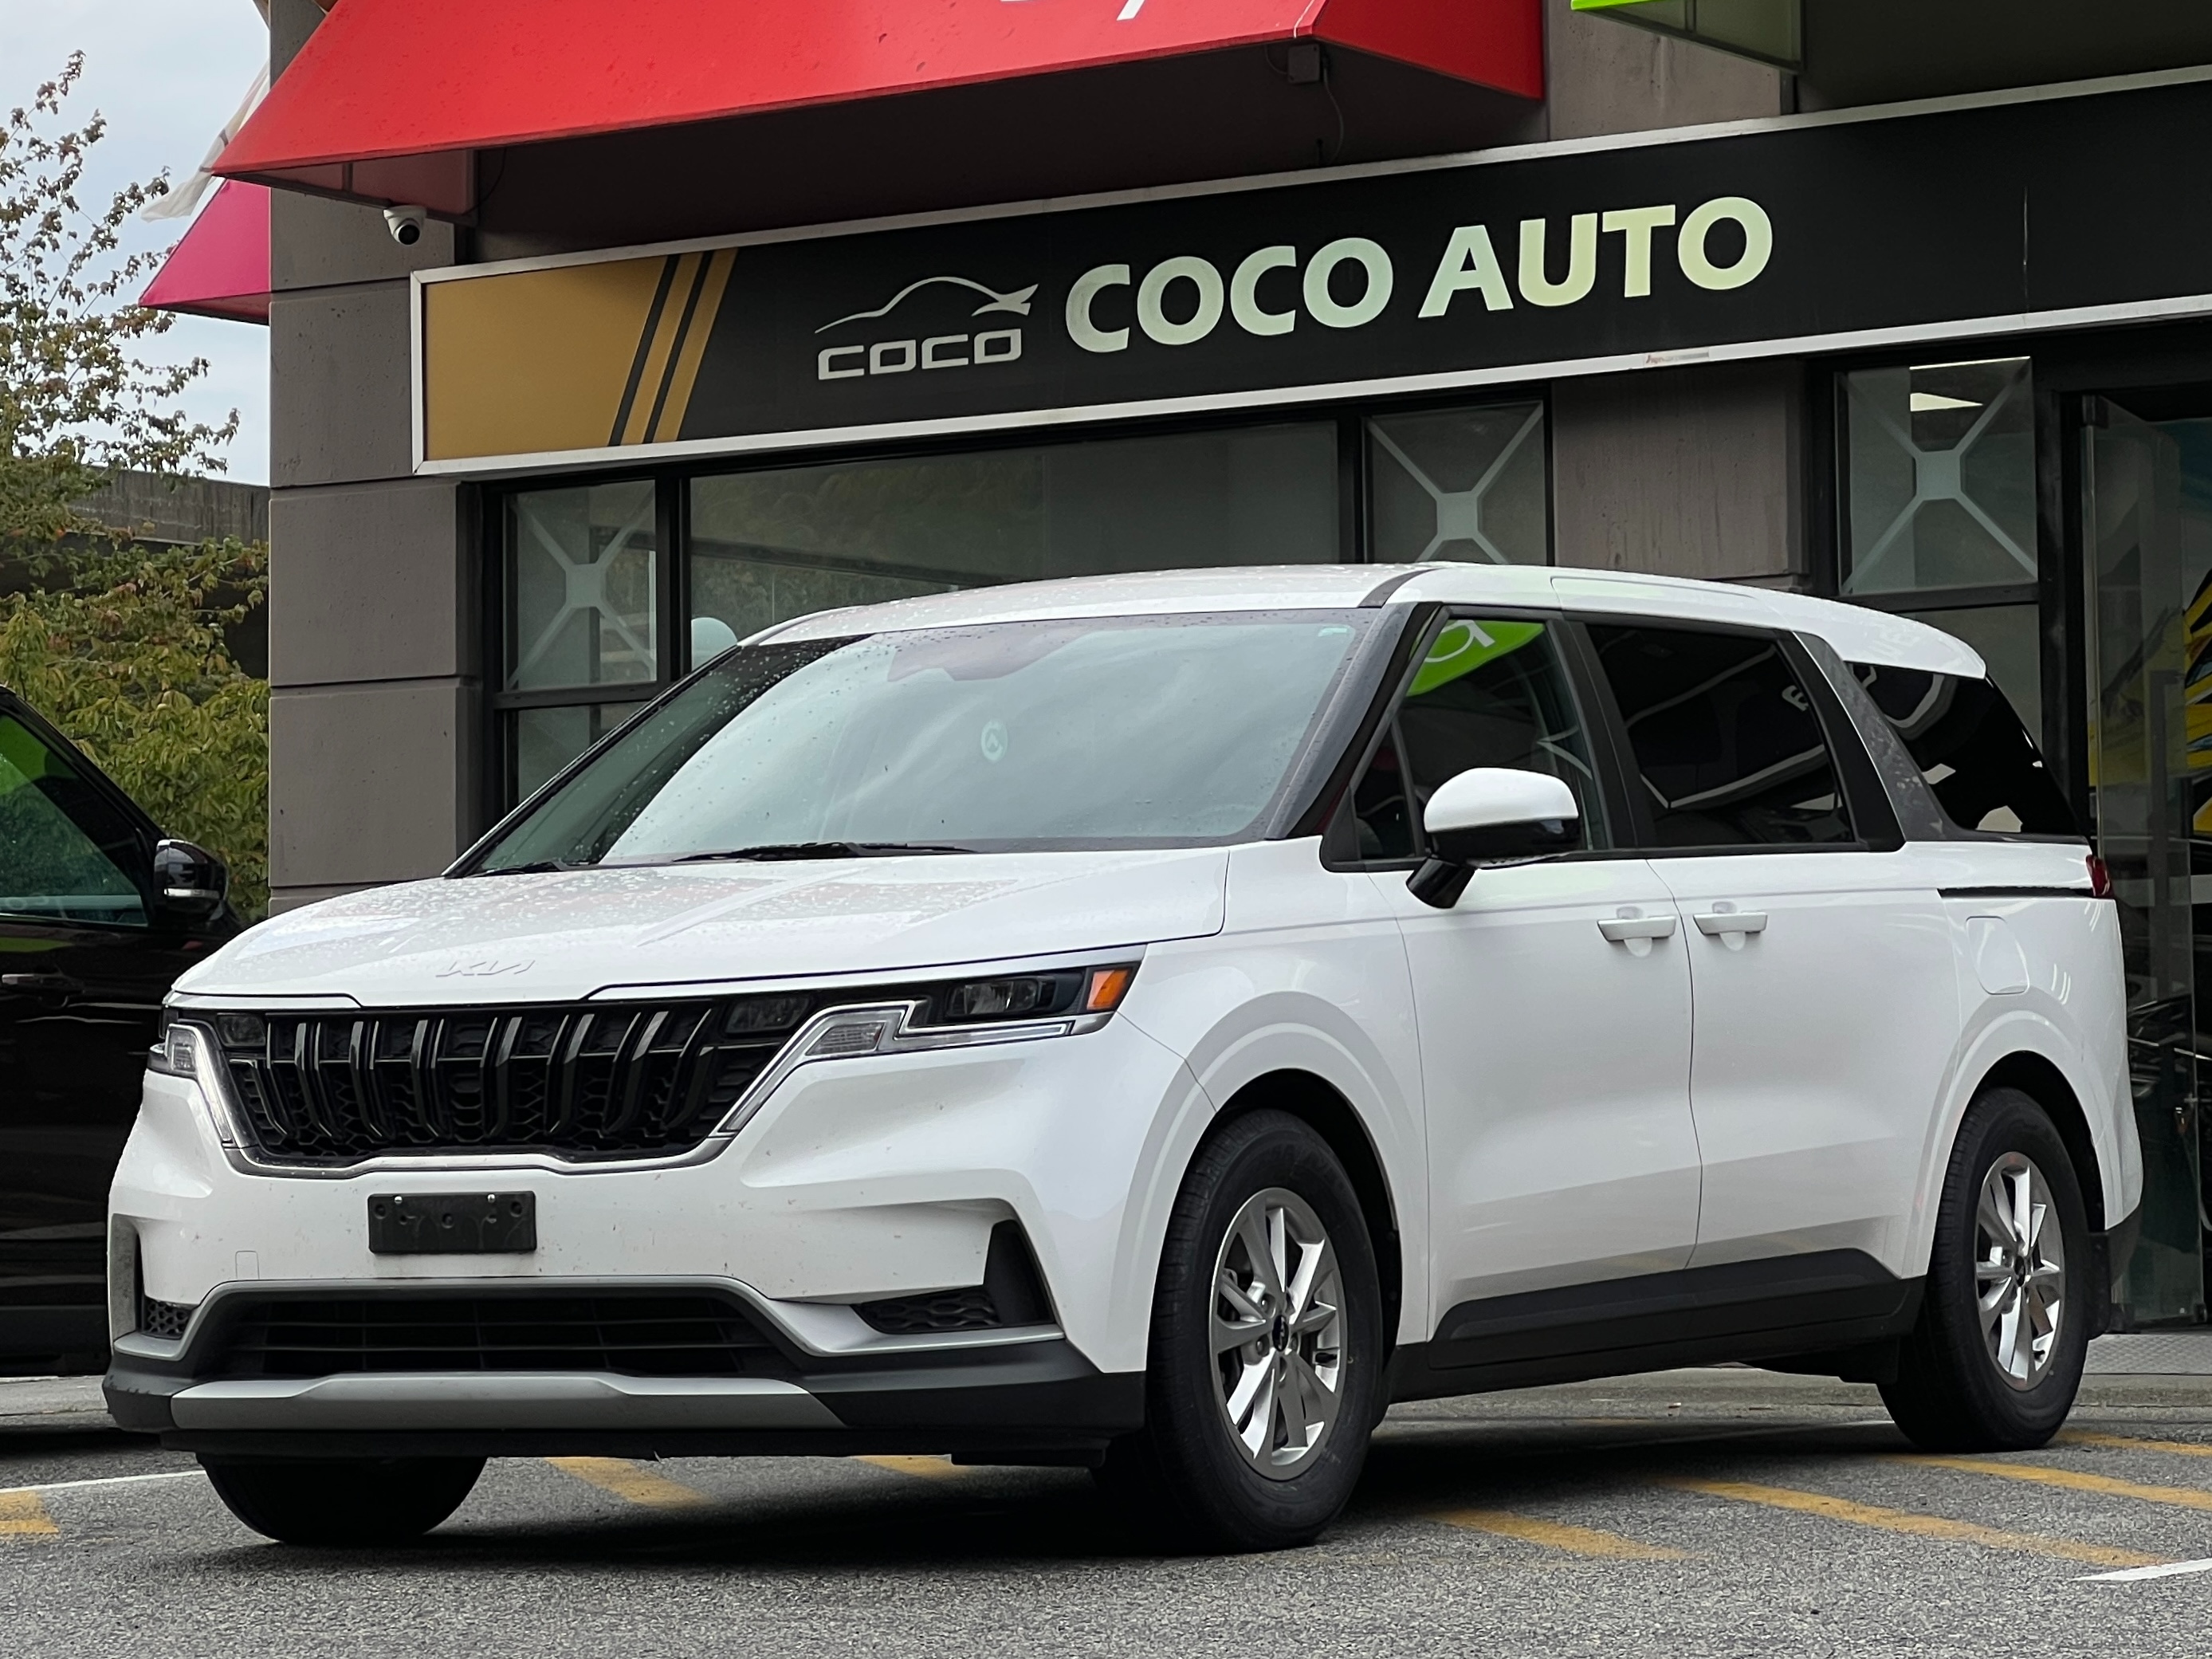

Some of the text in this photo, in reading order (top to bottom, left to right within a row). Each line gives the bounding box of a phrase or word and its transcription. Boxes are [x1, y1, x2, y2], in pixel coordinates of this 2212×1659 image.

[1065, 196, 1773, 353] COCO AUTO
[817, 328, 1023, 381] COCO
